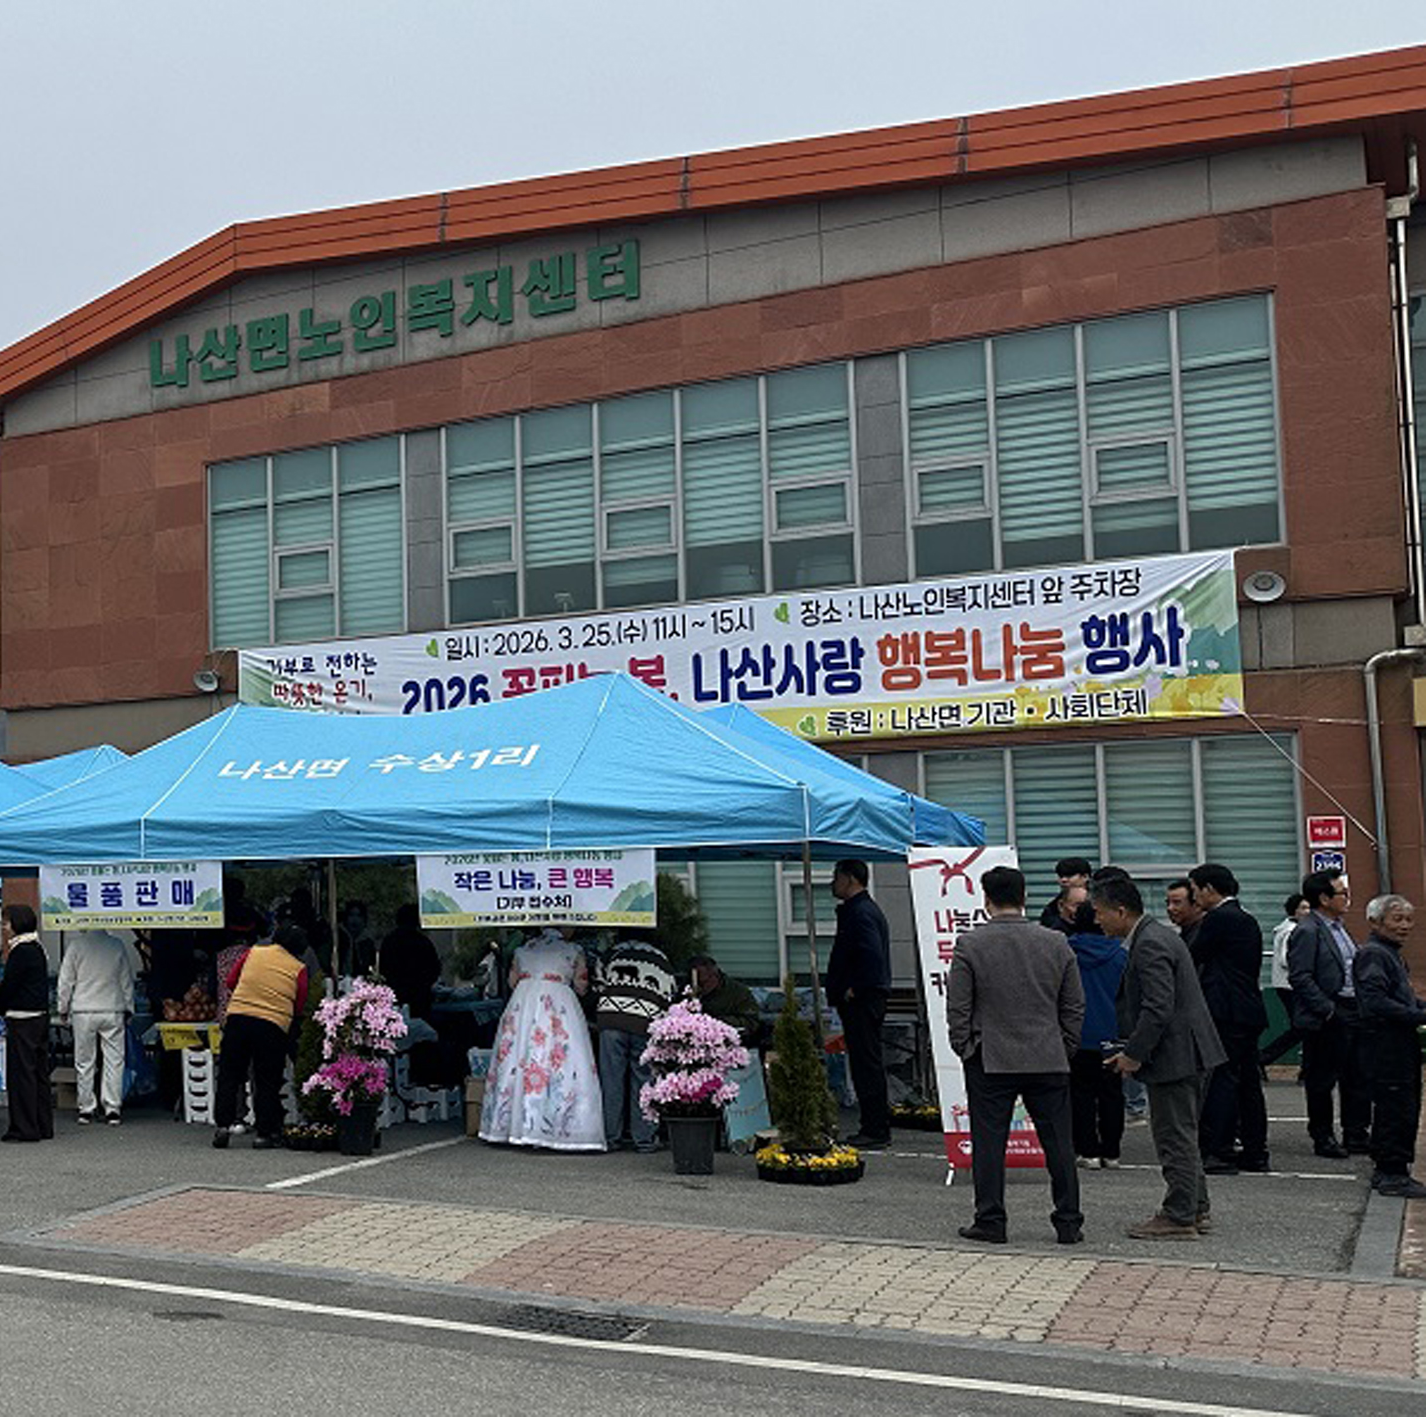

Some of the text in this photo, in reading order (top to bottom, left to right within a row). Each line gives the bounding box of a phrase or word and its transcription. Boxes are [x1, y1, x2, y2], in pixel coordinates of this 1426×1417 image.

[149, 238, 641, 388] 나산면노인복지센터
[860, 578, 1035, 620] 나산노인복지센터
[1041, 577, 1065, 604] 앞
[1071, 567, 1142, 601] 주차장
[326, 652, 378, 678] 전하는
[402, 675, 491, 715] 2026
[692, 636, 865, 702] 나산사랑
[876, 621, 1066, 691] 행복나눔
[1080, 605, 1185, 676] 행사
[273, 679, 373, 706] 따뜻한 온기,
[890, 704, 962, 731] 나산면
[968, 701, 1017, 726] 기관
[1045, 688, 1148, 722] 사회단체
[217, 744, 542, 780] 나산면 수상1리
[454, 867, 615, 892] 작은 나눔, 큰 행복
